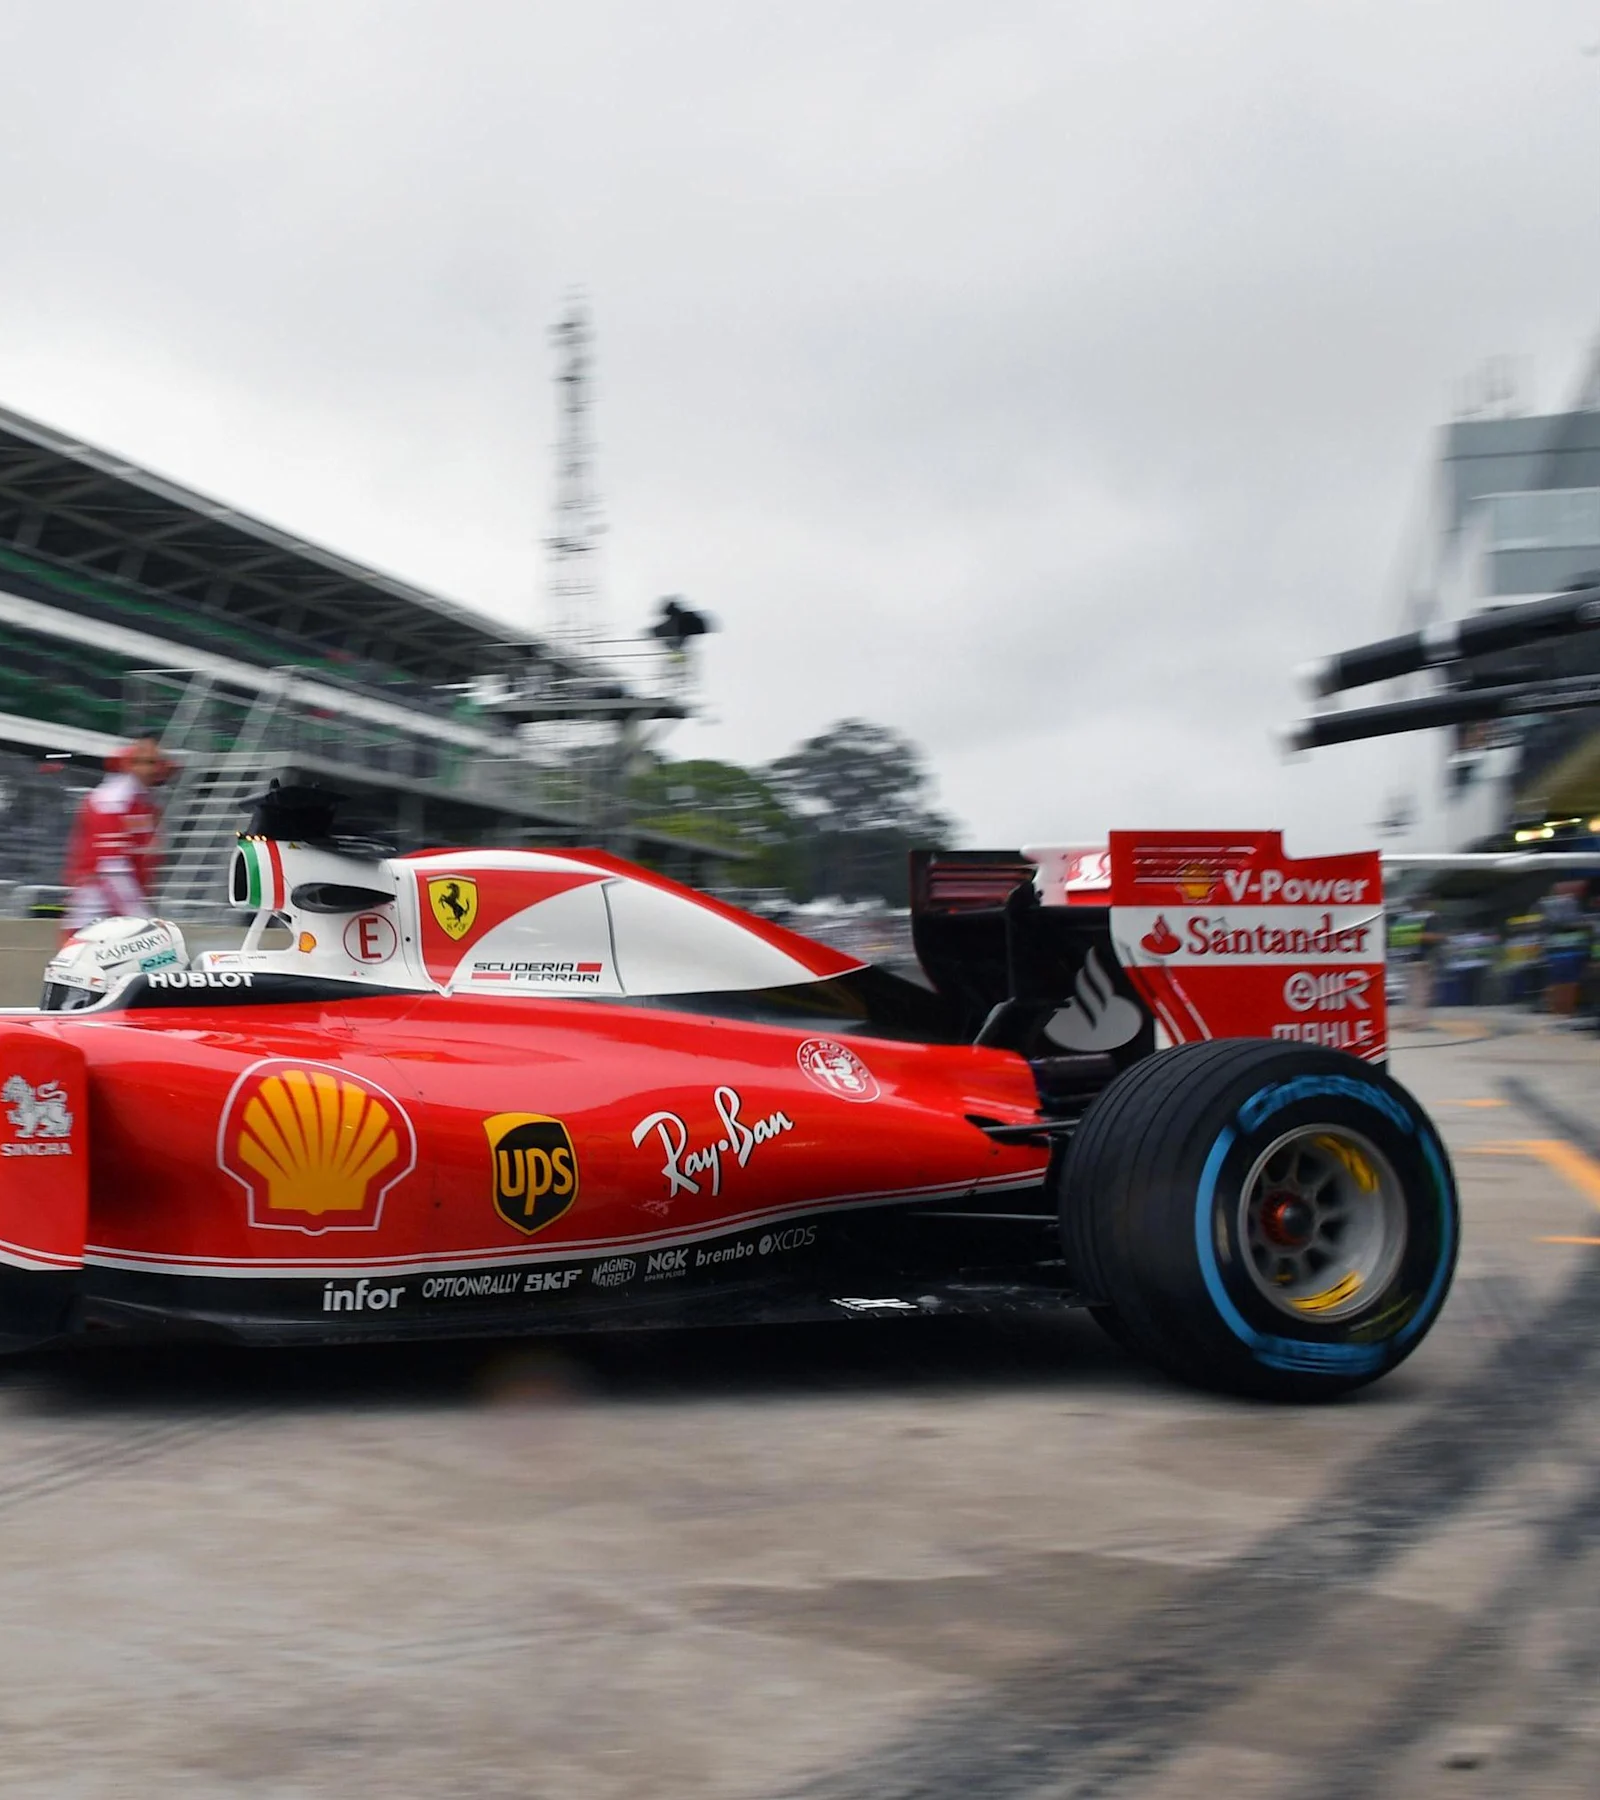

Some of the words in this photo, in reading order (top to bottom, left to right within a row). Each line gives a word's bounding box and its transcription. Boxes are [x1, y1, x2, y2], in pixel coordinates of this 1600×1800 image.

[1223, 868, 1370, 903] V-Power
[358, 917, 382, 959] E
[1186, 911, 1371, 955] Santander
[149, 972, 255, 988] HUBLOT
[473, 962, 574, 972] SCUDERIA
[514, 972, 601, 983] FERRARI
[1271, 1019, 1373, 1047] MAHLE
[498, 1147, 573, 1216] ups
[770, 1225, 818, 1254] XCDS
[646, 1248, 690, 1274] NGK
[695, 1241, 754, 1267] brembo
[524, 1268, 583, 1293] SKF
[323, 1279, 406, 1312] infor
